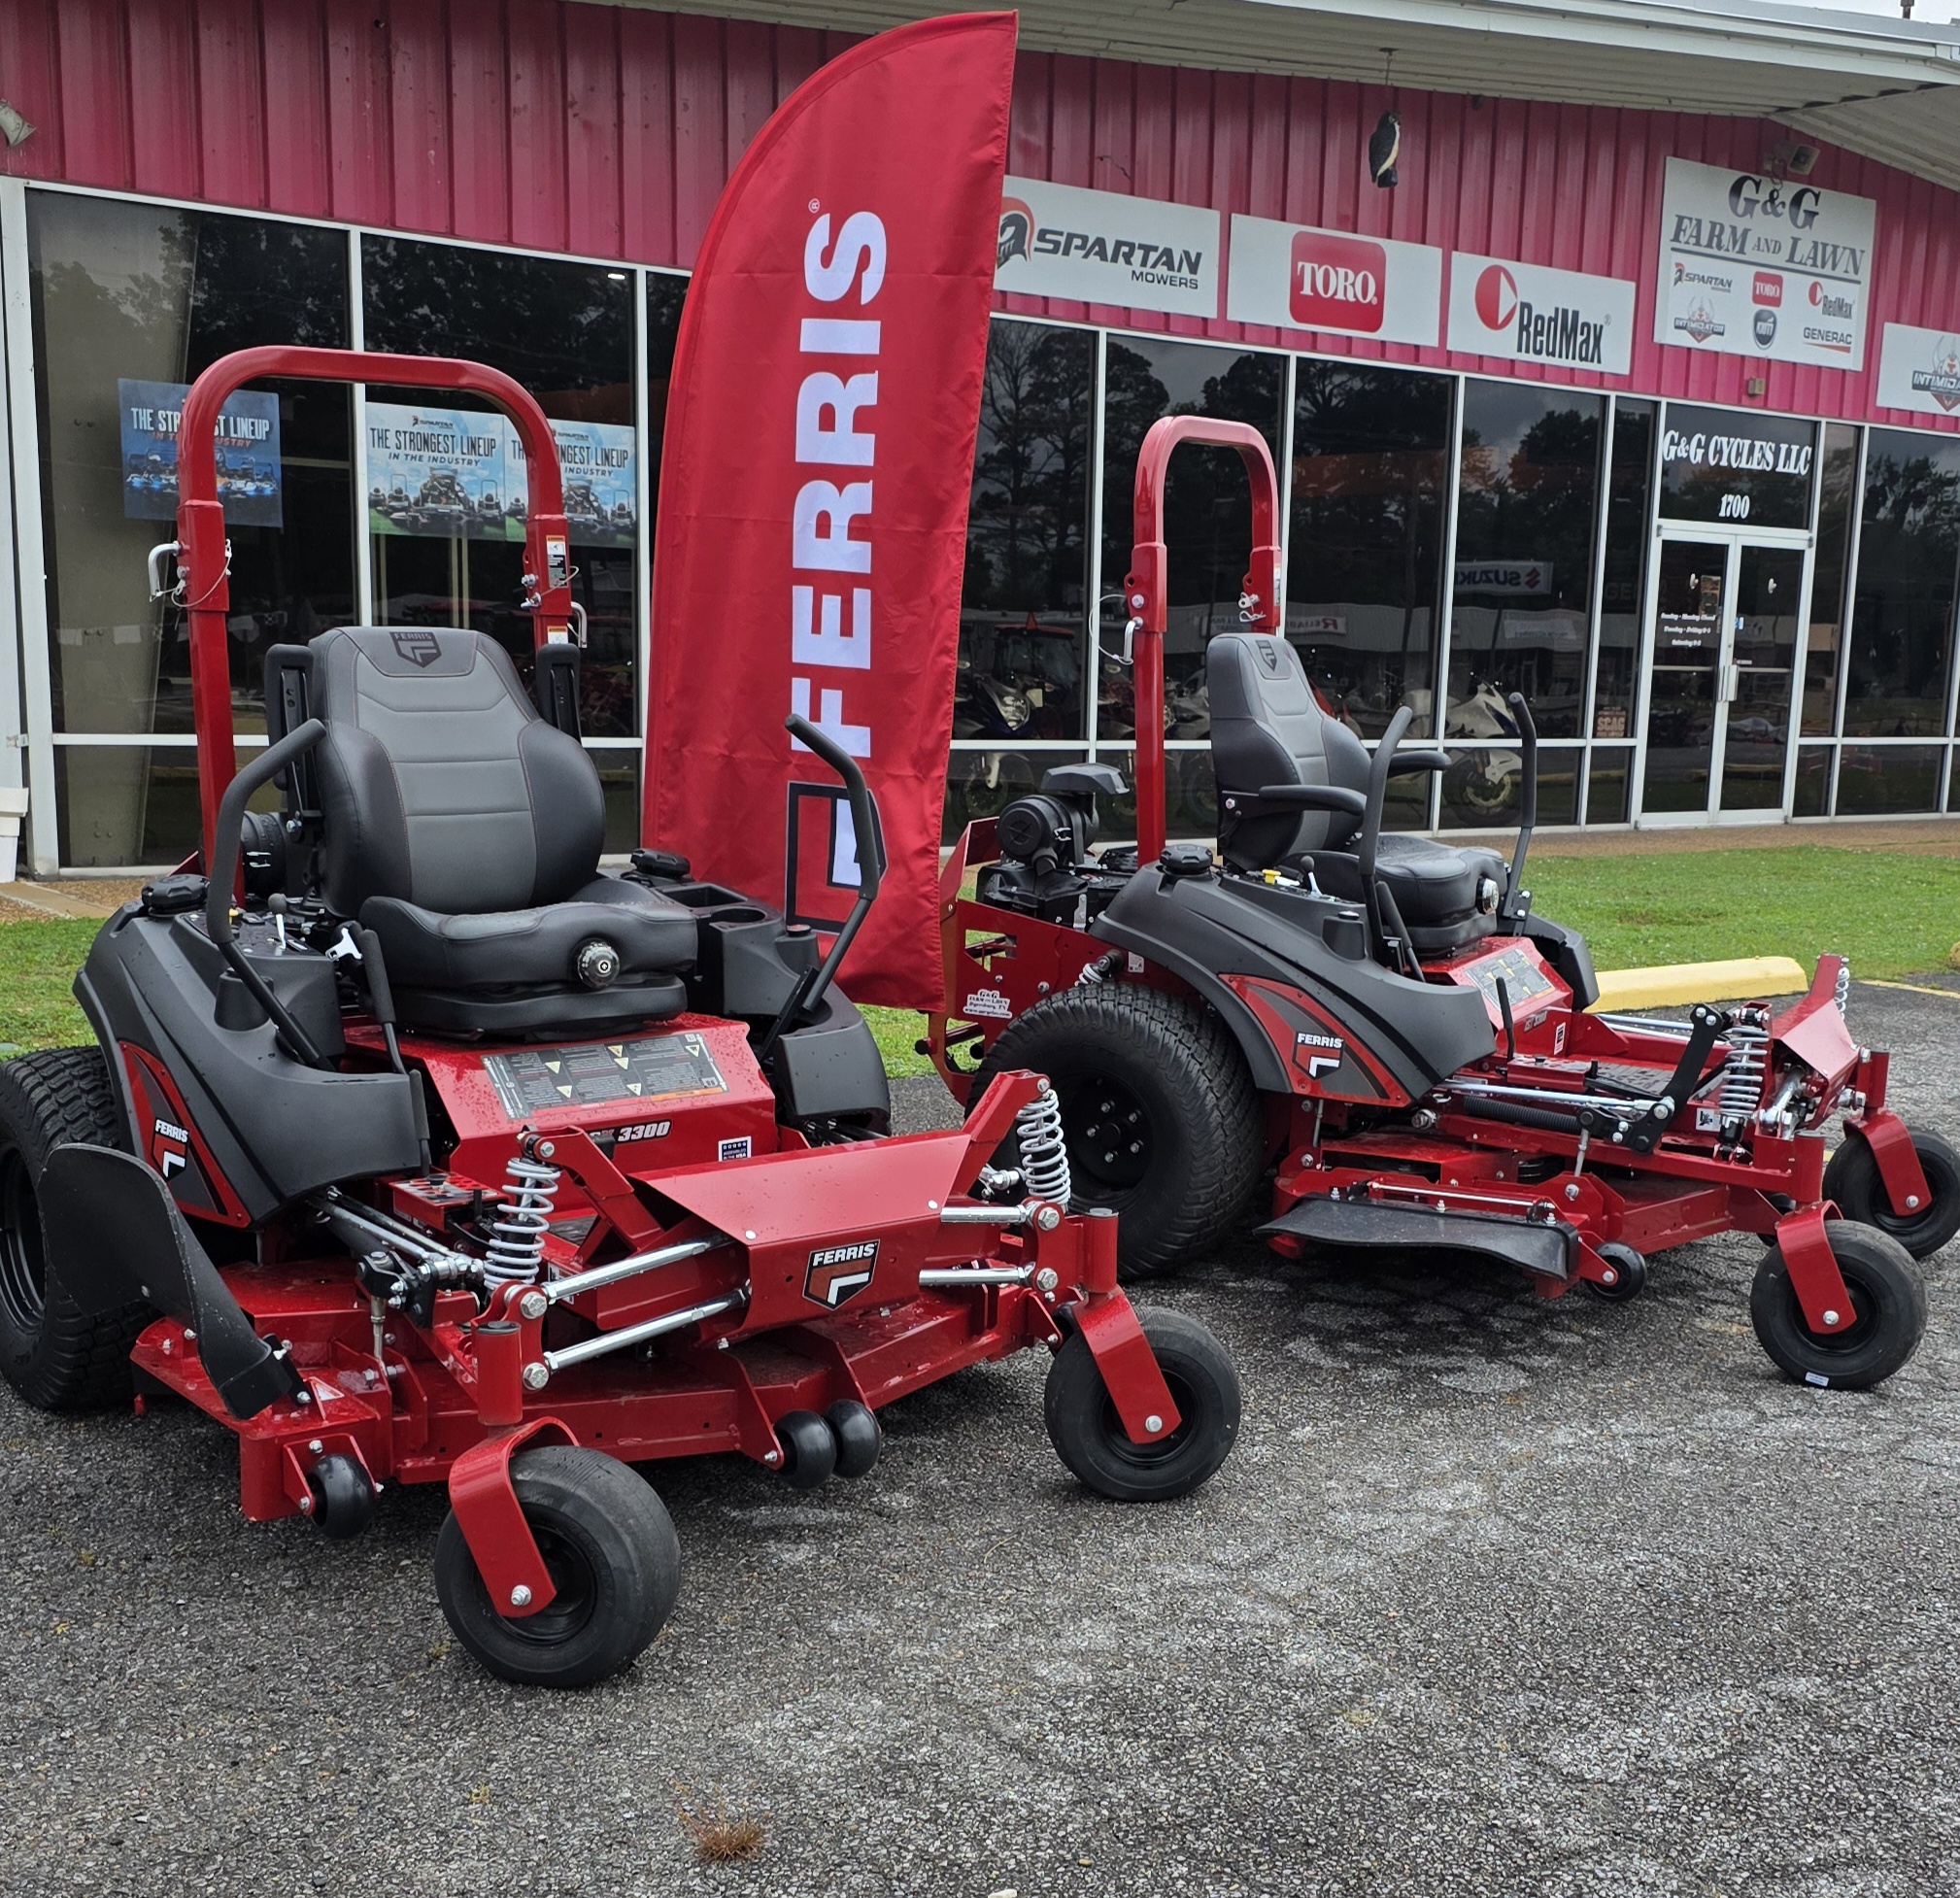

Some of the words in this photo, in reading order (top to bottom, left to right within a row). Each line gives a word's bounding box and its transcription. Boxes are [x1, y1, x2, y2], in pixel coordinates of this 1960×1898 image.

[1728, 175, 1822, 230] G&G
[1032, 228, 1202, 276] SPARTAN
[1670, 214, 1752, 255] FARM
[1752, 236, 1781, 254] AND
[1784, 236, 1865, 276] LAWN
[1131, 270, 1200, 289] MOWERS
[1297, 260, 1377, 304] TORO
[1683, 272, 1733, 288] SPARTAN
[1755, 281, 1780, 298] TORO
[1516, 301, 1603, 364] RedMax
[1803, 326, 1853, 345] GENERAC
[130, 407, 154, 430] THE
[157, 409, 225, 437] STRST
[229, 416, 270, 440] LINEUP
[370, 427, 390, 450] THE
[394, 429, 456, 455] STRONGEST
[460, 434, 496, 458] LINEUP
[1663, 429, 1706, 465] G&G
[1707, 434, 1775, 471] CYCLES
[1775, 443, 1812, 476] LLC
[389, 452, 400, 460] IN
[404, 453, 423, 462] THE
[427, 455, 481, 466] INDUSTRY
[594, 446, 628, 468] LINEUP
[564, 465, 614, 477] INDUSTRY
[790, 211, 887, 759] FERRIS
[1718, 493, 1750, 519] 1700
[1297, 1033, 1342, 1049] FERRIS
[155, 1118, 189, 1143] FERRIS
[617, 1121, 671, 1142] 3300
[812, 1242, 876, 1267] FERRIS
